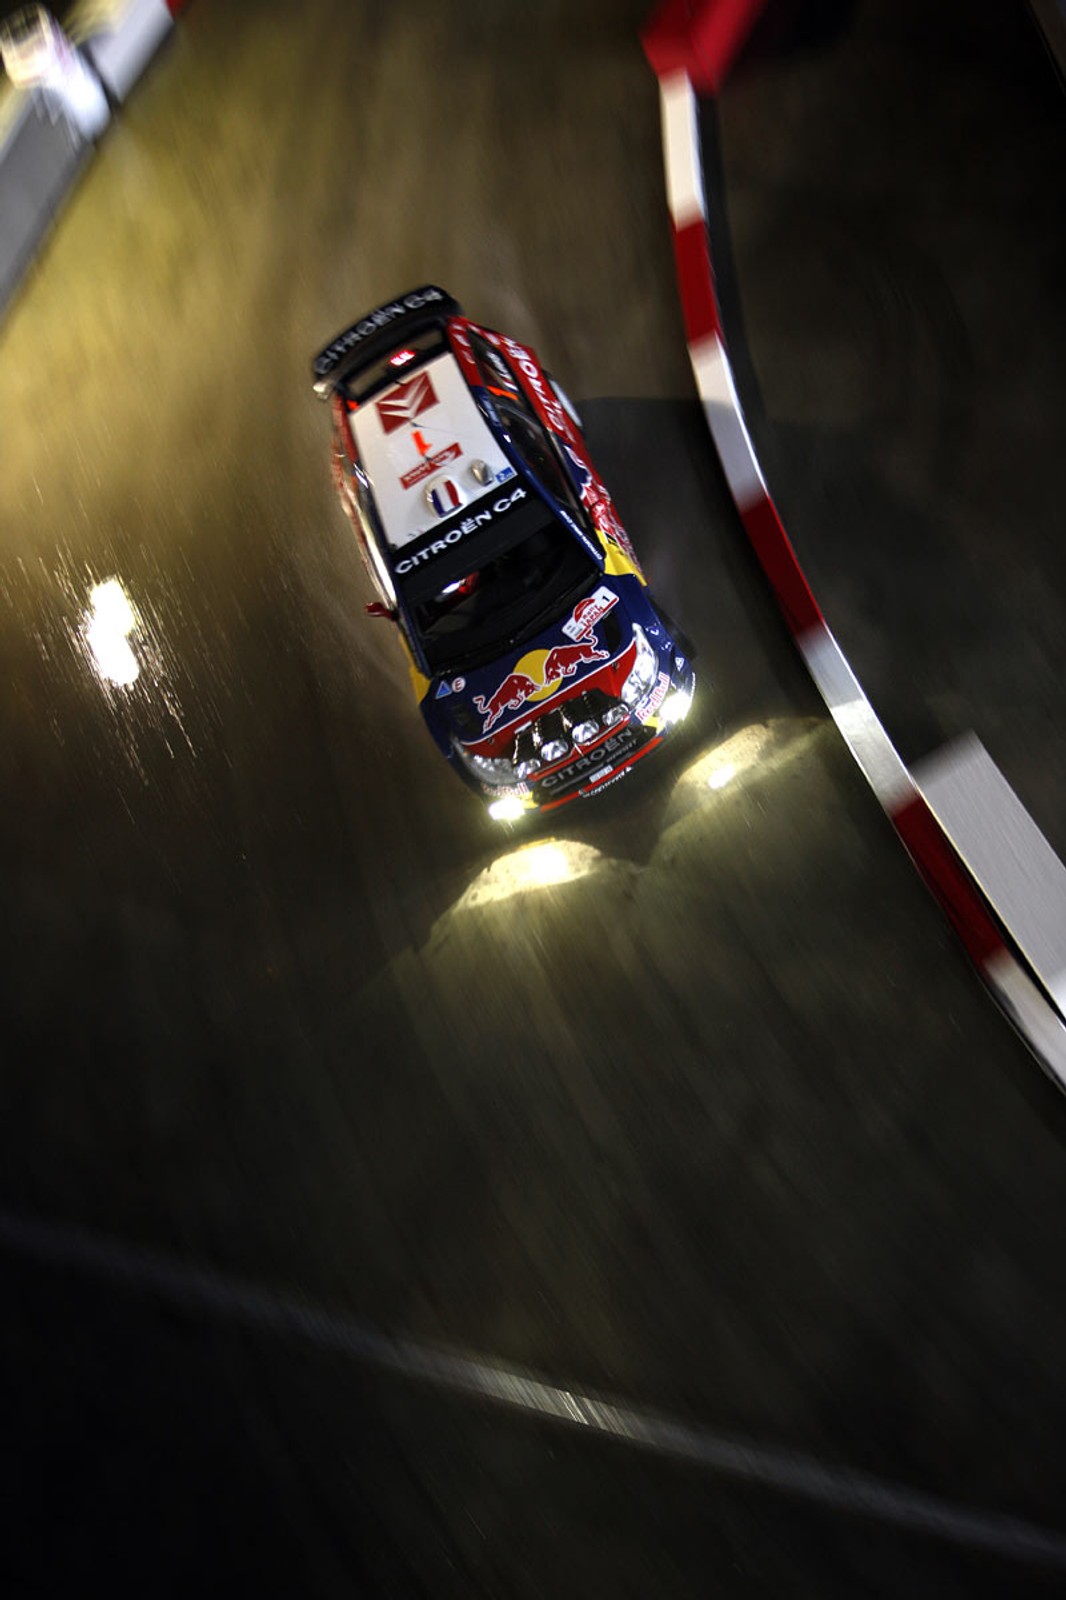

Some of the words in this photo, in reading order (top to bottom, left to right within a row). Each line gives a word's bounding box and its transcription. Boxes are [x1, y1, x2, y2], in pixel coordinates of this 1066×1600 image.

[404, 289, 443, 309] C4
[395, 510, 493, 574] CITROËN
[493, 487, 527, 512] C4
[602, 595, 611, 603] 1
[454, 680, 462, 691] E
[541, 727, 634, 788] CITROËN
